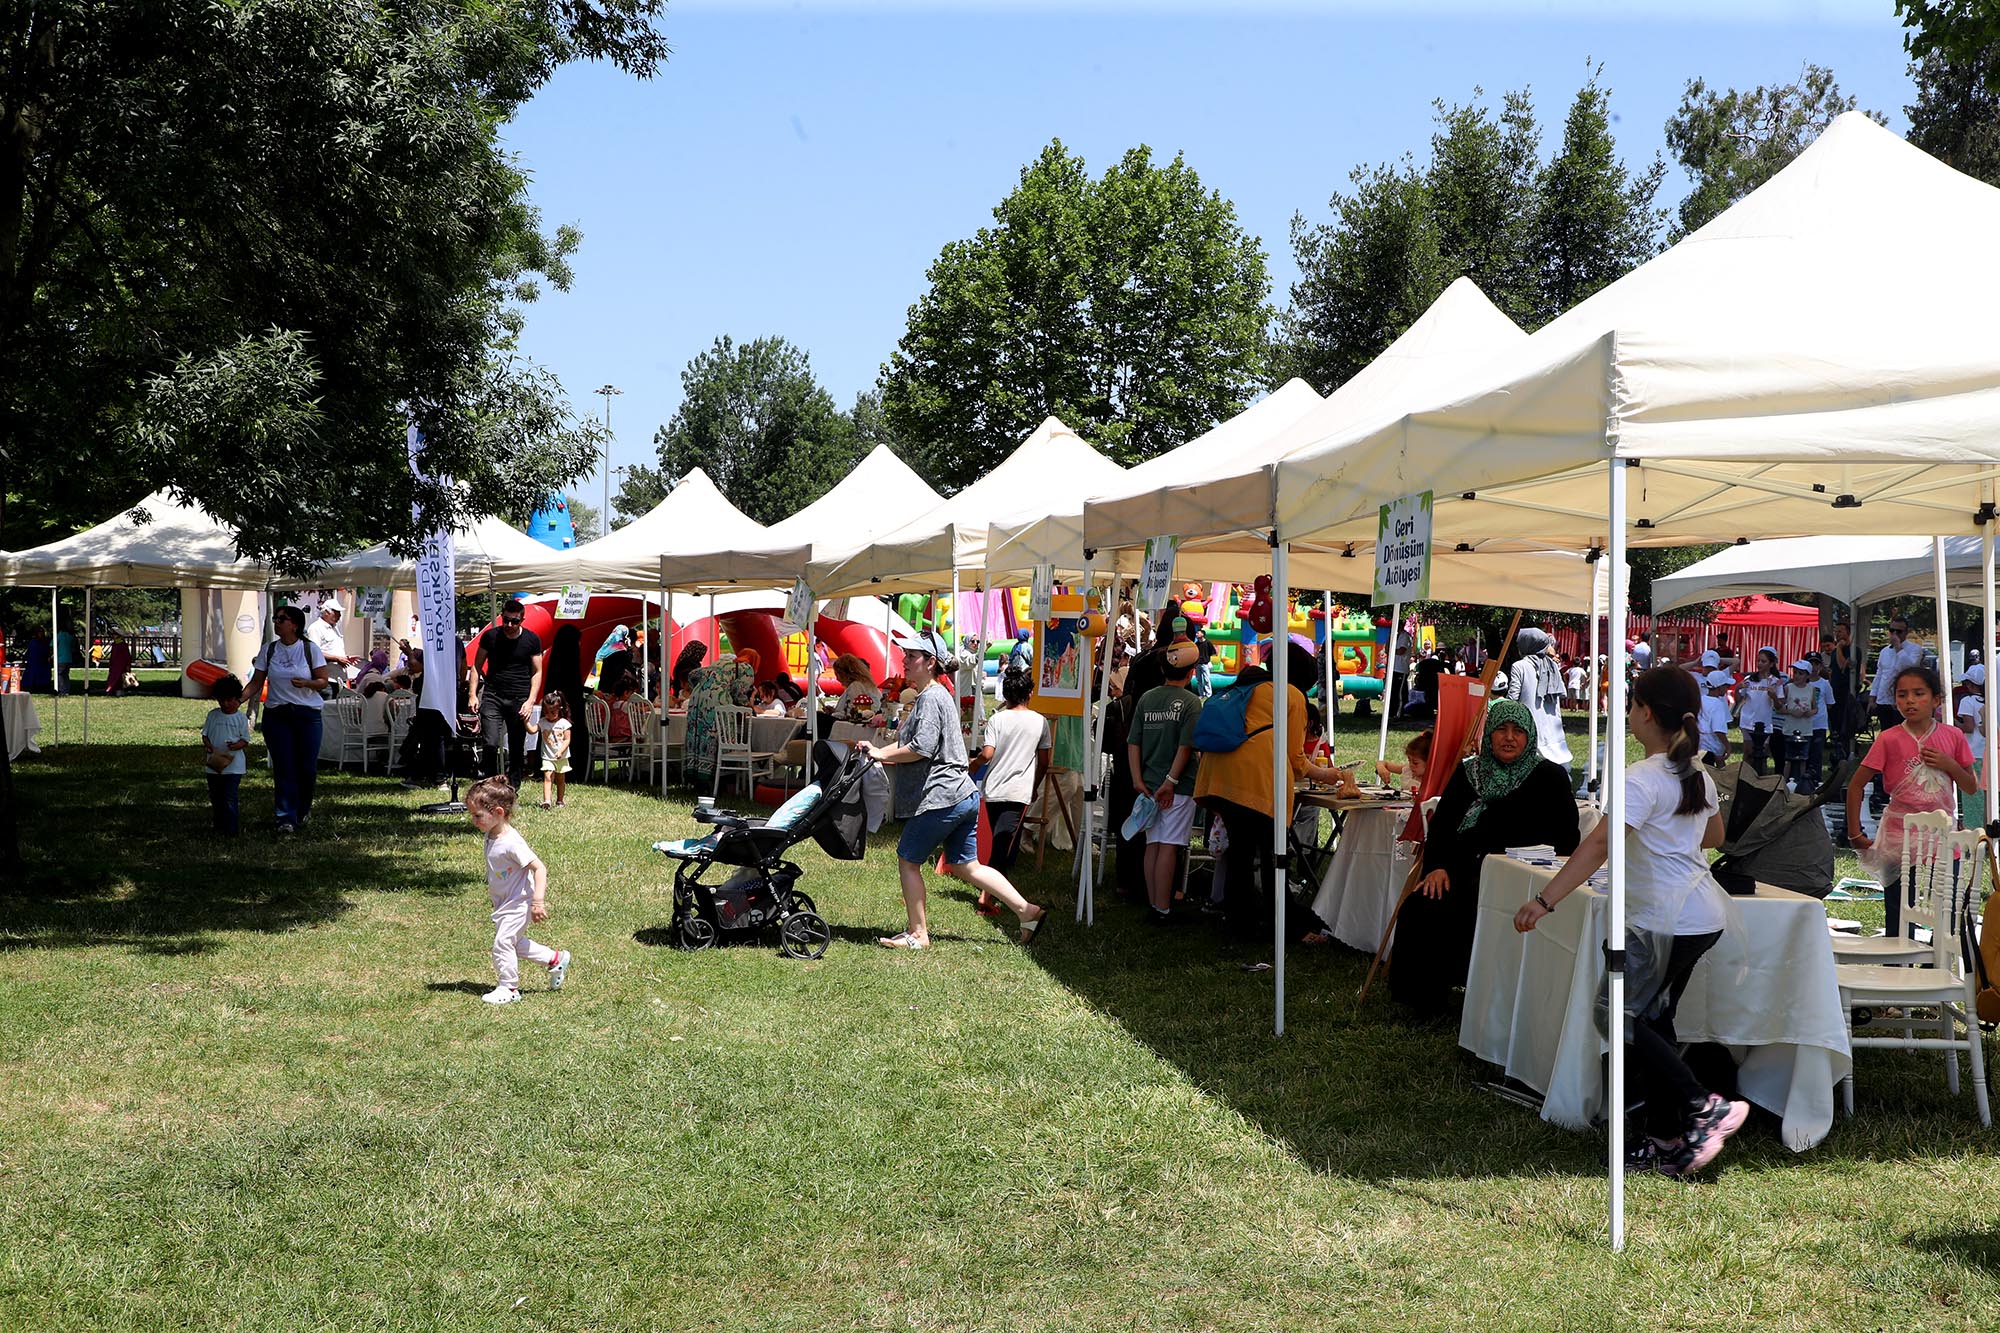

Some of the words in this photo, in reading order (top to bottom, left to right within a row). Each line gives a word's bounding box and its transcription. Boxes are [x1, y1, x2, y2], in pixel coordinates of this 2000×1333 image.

[1395, 515, 1414, 538] Geri
[1383, 539, 1425, 564] Dönüşüm
[1384, 561, 1421, 588] Atölyesi
